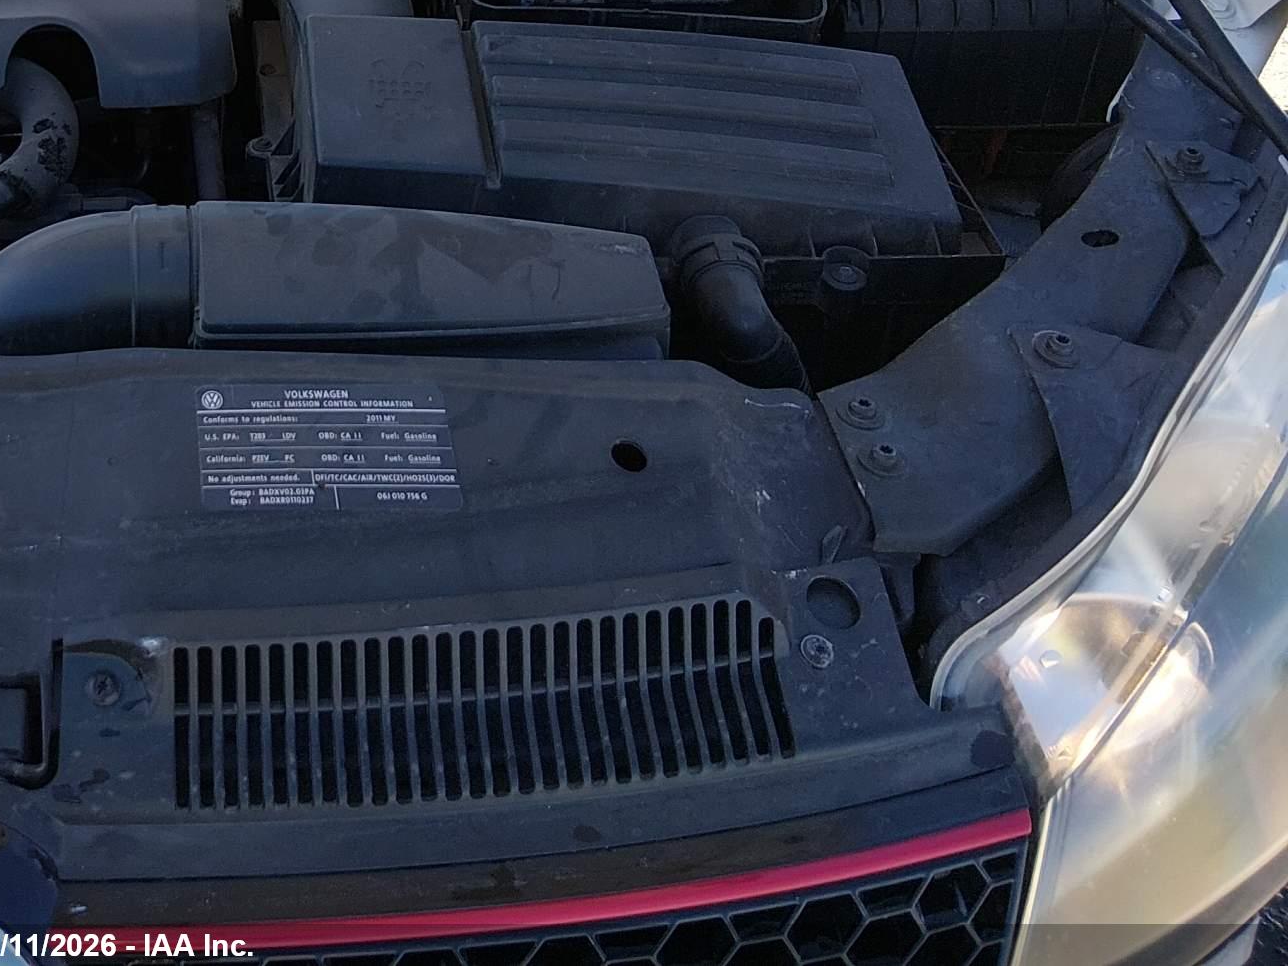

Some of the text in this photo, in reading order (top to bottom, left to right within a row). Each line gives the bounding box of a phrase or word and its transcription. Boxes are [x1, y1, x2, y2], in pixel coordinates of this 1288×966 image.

[284, 390, 349, 399] VOLKSWAGEN
[251, 400, 414, 408] VEHICLE EMISSION CONTROL INFORMATION
[203, 415, 239, 424] Conforms
[253, 415, 298, 425] regulations:
[204, 432, 219, 440] U.S.
[318, 432, 337, 440] OBD:
[381, 432, 437, 440] Fuel: Gasoline
[206, 454, 246, 463] California:
[408, 454, 441, 462] Gasoline
[208, 473, 301, 484] No adjustments needed.
